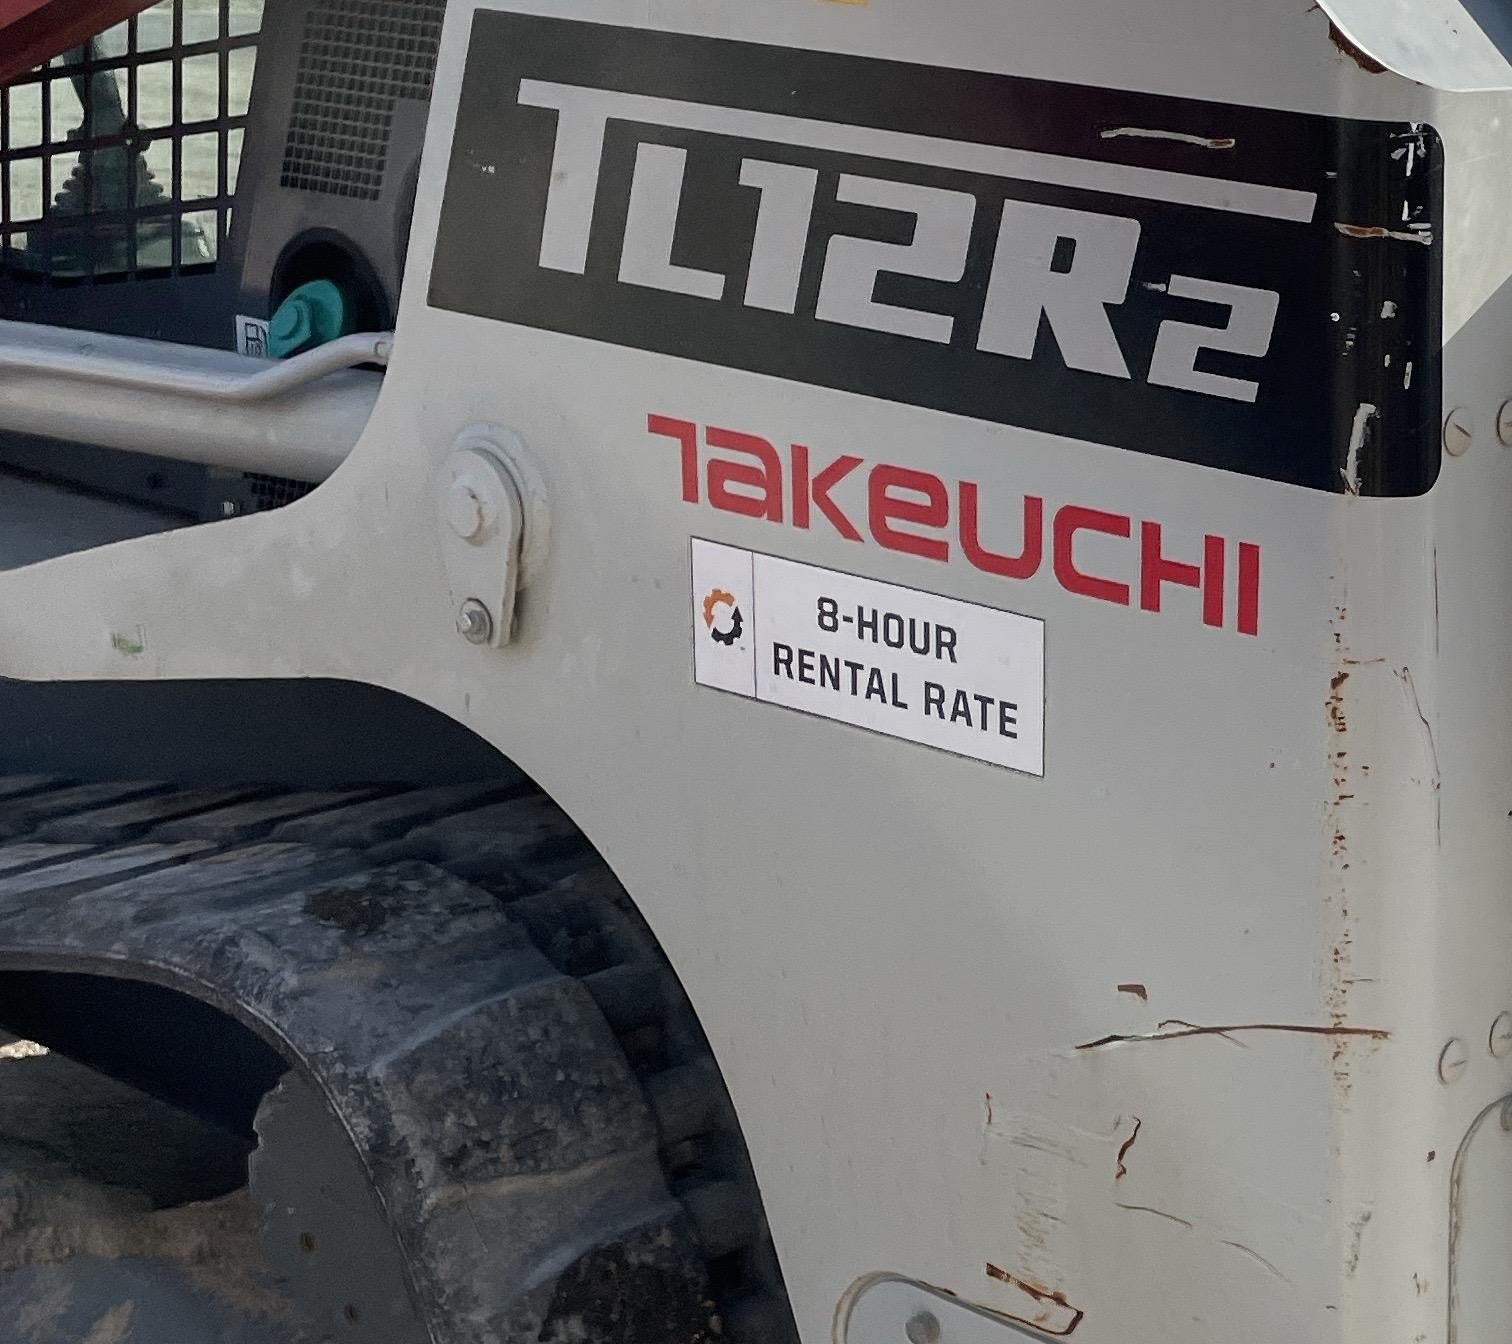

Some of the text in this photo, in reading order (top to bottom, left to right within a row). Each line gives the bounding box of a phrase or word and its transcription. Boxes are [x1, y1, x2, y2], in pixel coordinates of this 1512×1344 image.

[517, 77, 1318, 404] TL12R2
[816, 596, 958, 664] 8-HOUR
[773, 642, 1019, 739] RENTAL RATE
